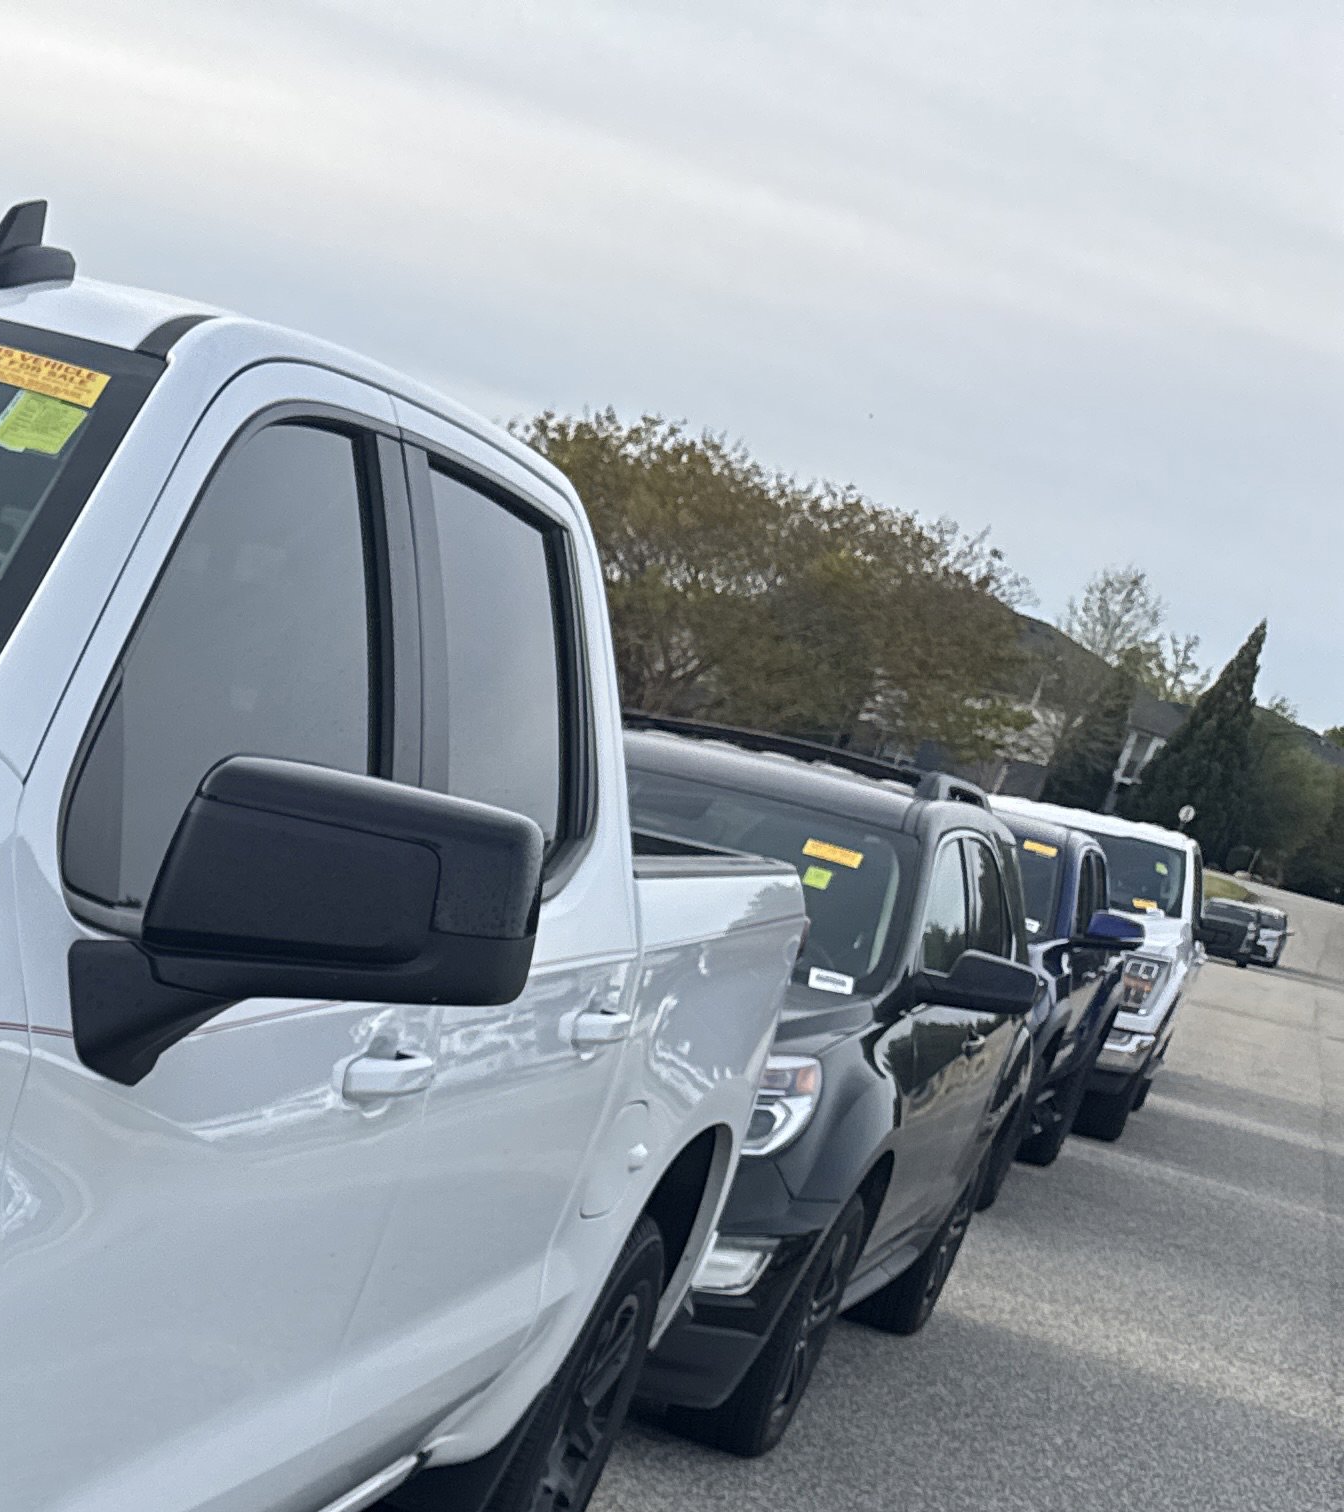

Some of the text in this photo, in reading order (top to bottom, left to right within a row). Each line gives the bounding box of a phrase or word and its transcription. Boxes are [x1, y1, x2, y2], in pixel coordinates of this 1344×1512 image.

[9, 360, 42, 374] FOR
[48, 369, 89, 386] SALE
[20, 354, 97, 381] VEHICLE
